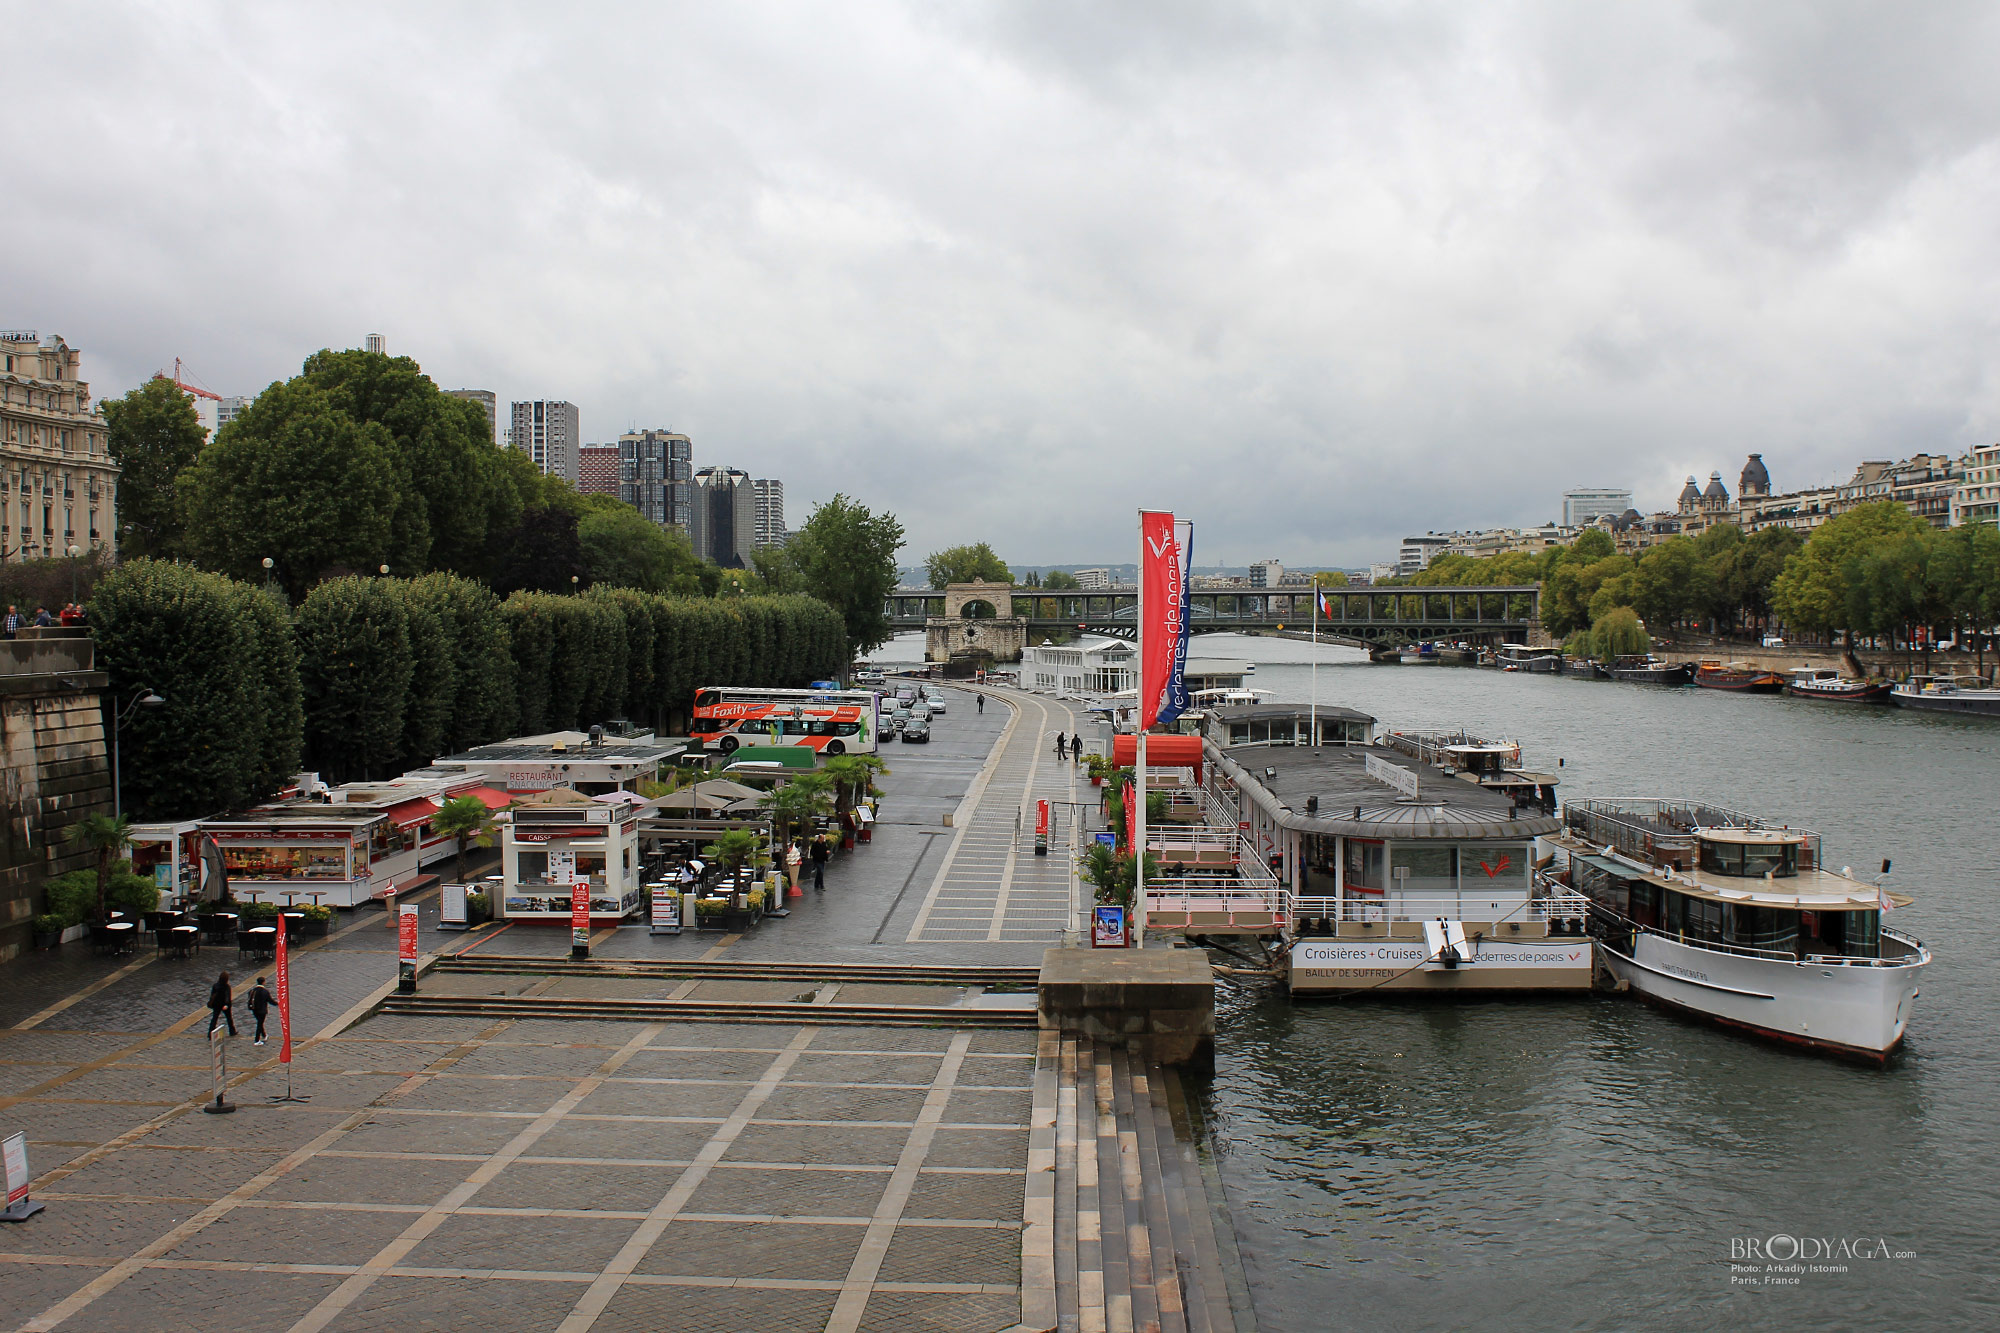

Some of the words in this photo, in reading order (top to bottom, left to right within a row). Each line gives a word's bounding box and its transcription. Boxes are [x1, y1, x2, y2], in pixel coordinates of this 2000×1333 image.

[713, 702, 748, 718] Foxity
[510, 772, 563, 781] RESTAURANT
[510, 781, 550, 789] SNACKING
[1305, 948, 1366, 960] Croisières
[1377, 948, 1423, 960] Cruises
[1471, 952, 1516, 962] edettes
[1518, 952, 1533, 962] de
[1305, 969, 1336, 978] BAILLY
[1338, 969, 1351, 977] DE
[1353, 969, 1394, 978] SUFFREN
